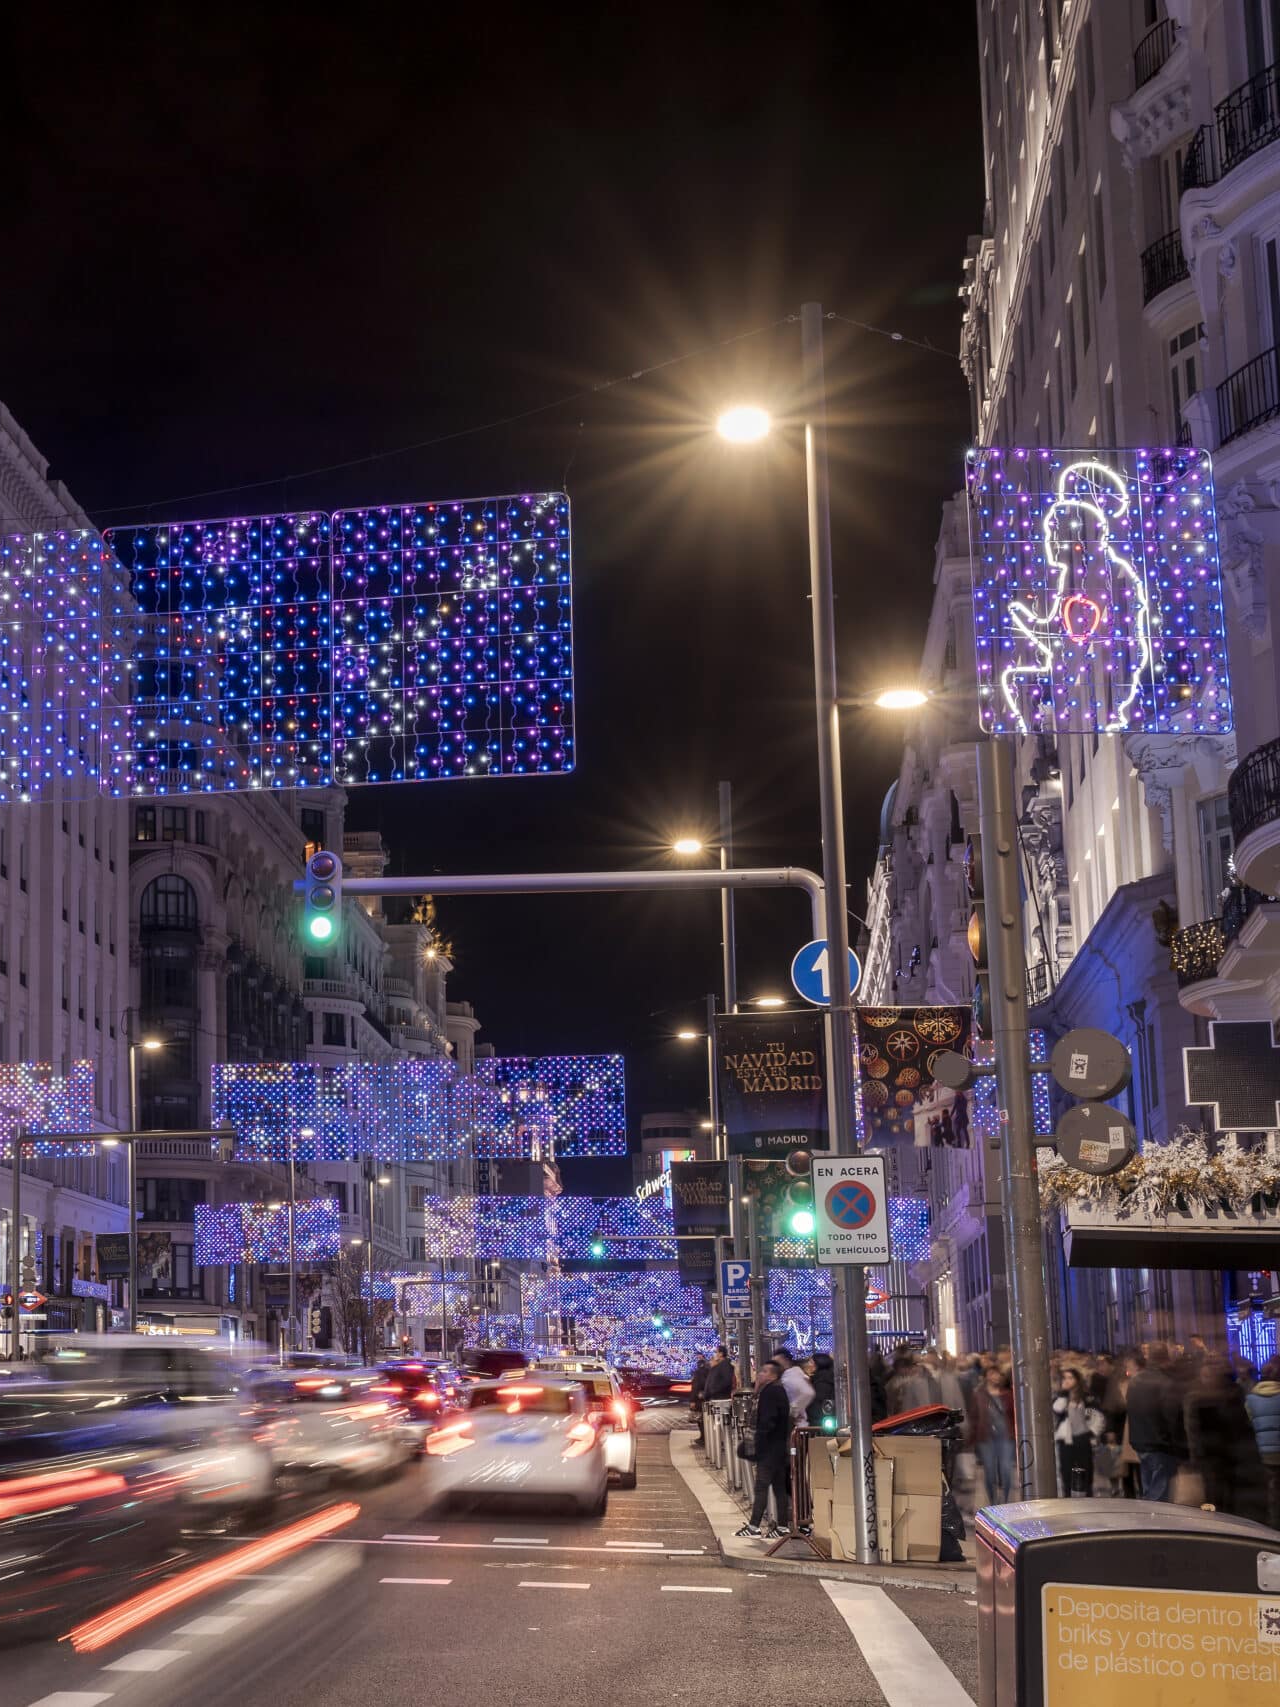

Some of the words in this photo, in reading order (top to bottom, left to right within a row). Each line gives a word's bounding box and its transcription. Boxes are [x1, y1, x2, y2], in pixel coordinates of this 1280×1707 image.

[766, 1042, 785, 1052] TU
[723, 1051, 815, 1070] NAVIDAD
[770, 1066, 787, 1077] EN
[742, 1076, 823, 1093] MADRID
[767, 1135, 808, 1145] MADRID
[817, 1167, 833, 1177] EN
[840, 1166, 879, 1177] ACERA
[828, 1233, 852, 1241] TODO
[819, 1247, 831, 1255] DE
[836, 1246, 887, 1255] VEHÍCULOS
[727, 1265, 745, 1286] P
[1057, 1595, 1160, 1622] Deposita
[1165, 1603, 1242, 1627] dentro
[1058, 1623, 1112, 1647] briks
[1117, 1631, 1130, 1651] y
[1135, 1630, 1195, 1650] otros
[1057, 1649, 1089, 1671] de
[1094, 1649, 1185, 1677] plástico
[1190, 1660, 1206, 1678] o
